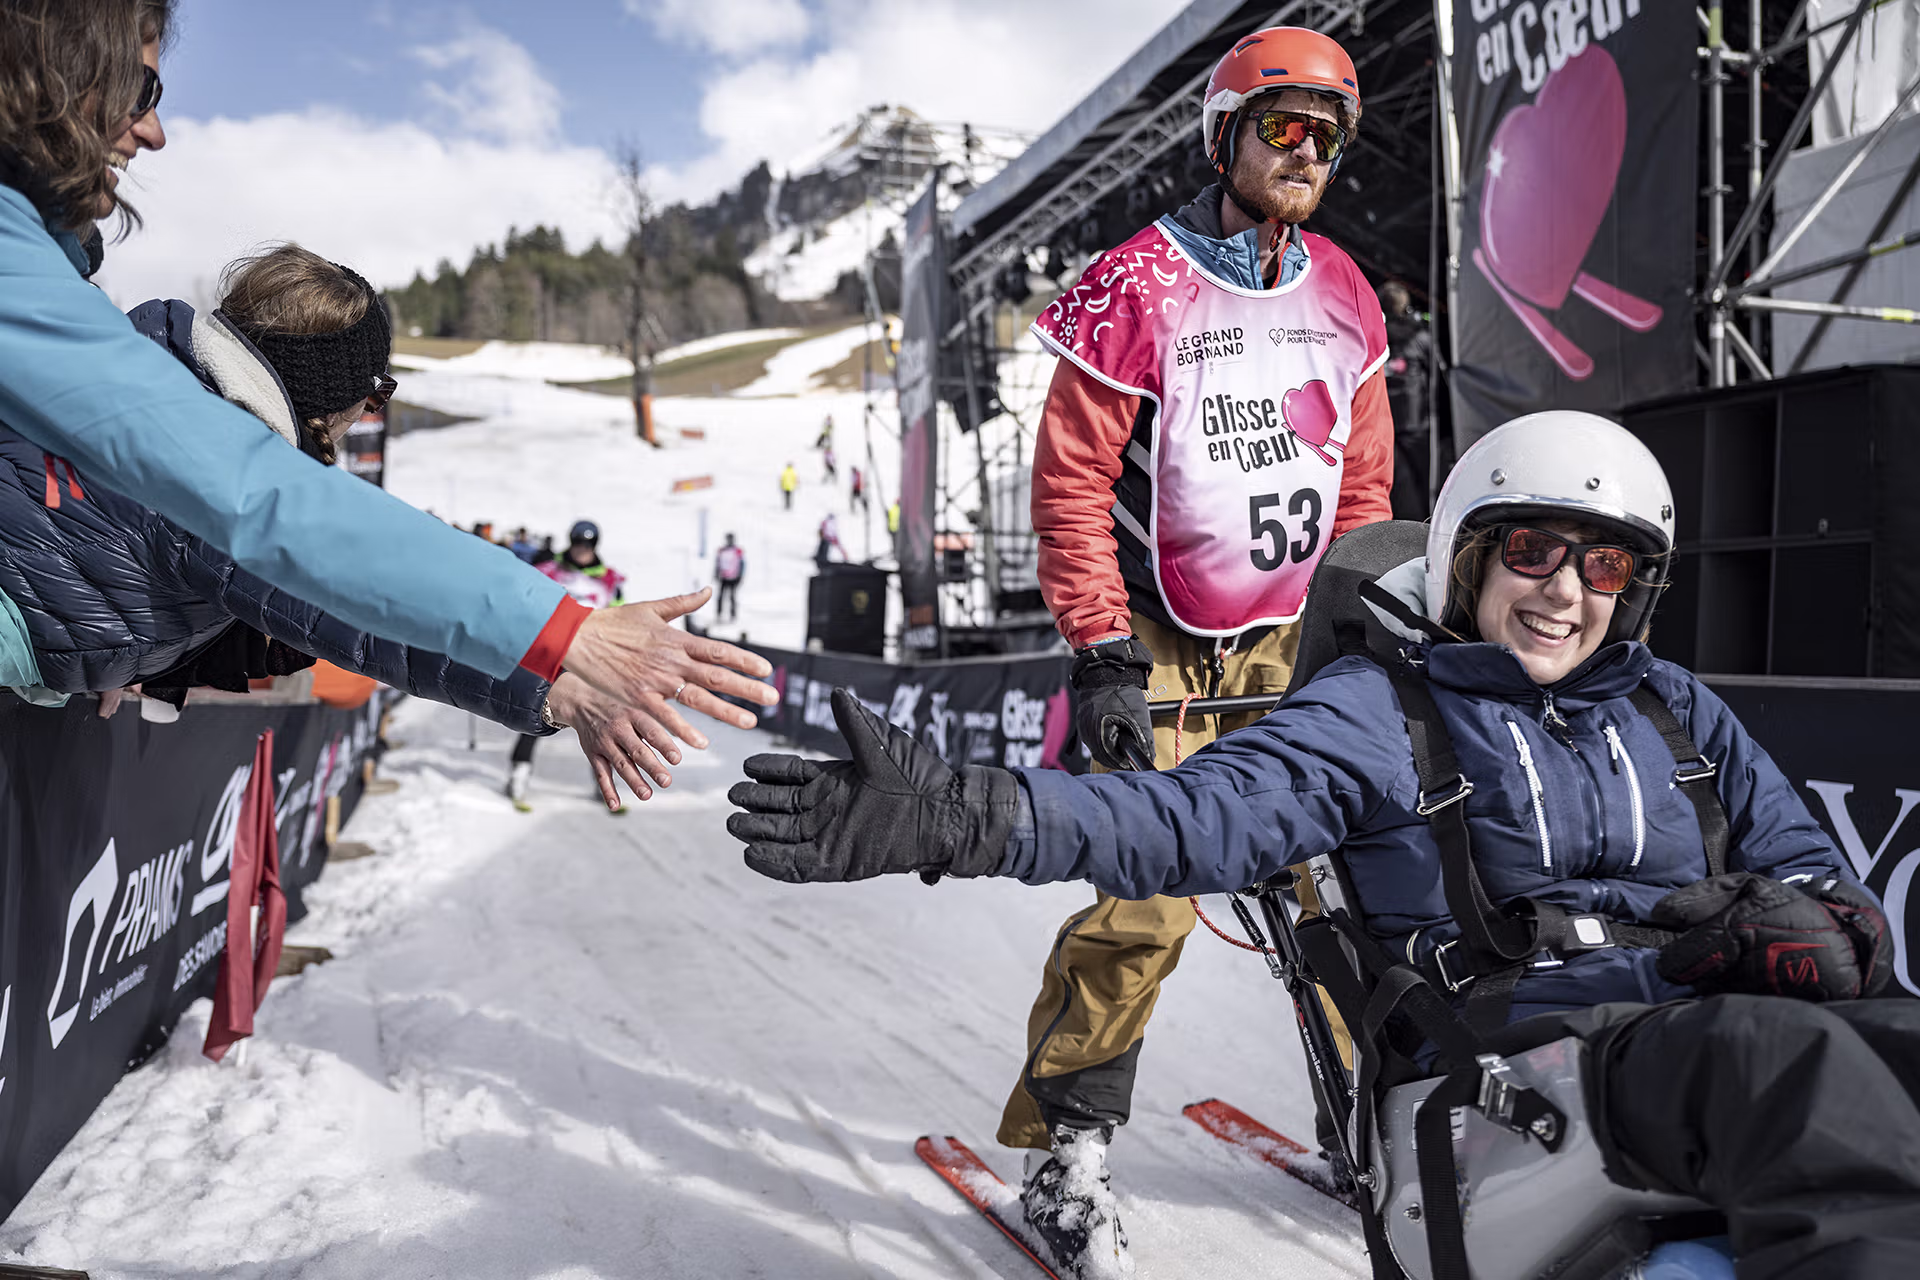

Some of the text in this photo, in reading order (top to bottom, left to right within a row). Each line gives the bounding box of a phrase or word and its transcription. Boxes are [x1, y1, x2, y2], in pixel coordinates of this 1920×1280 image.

[1175, 327, 1243, 352] LE GRAND
[1177, 342, 1244, 367] BORNAND
[1203, 394, 1277, 436] Glisse
[1208, 430, 1300, 473] en Cœur
[1249, 487, 1322, 572] 53
